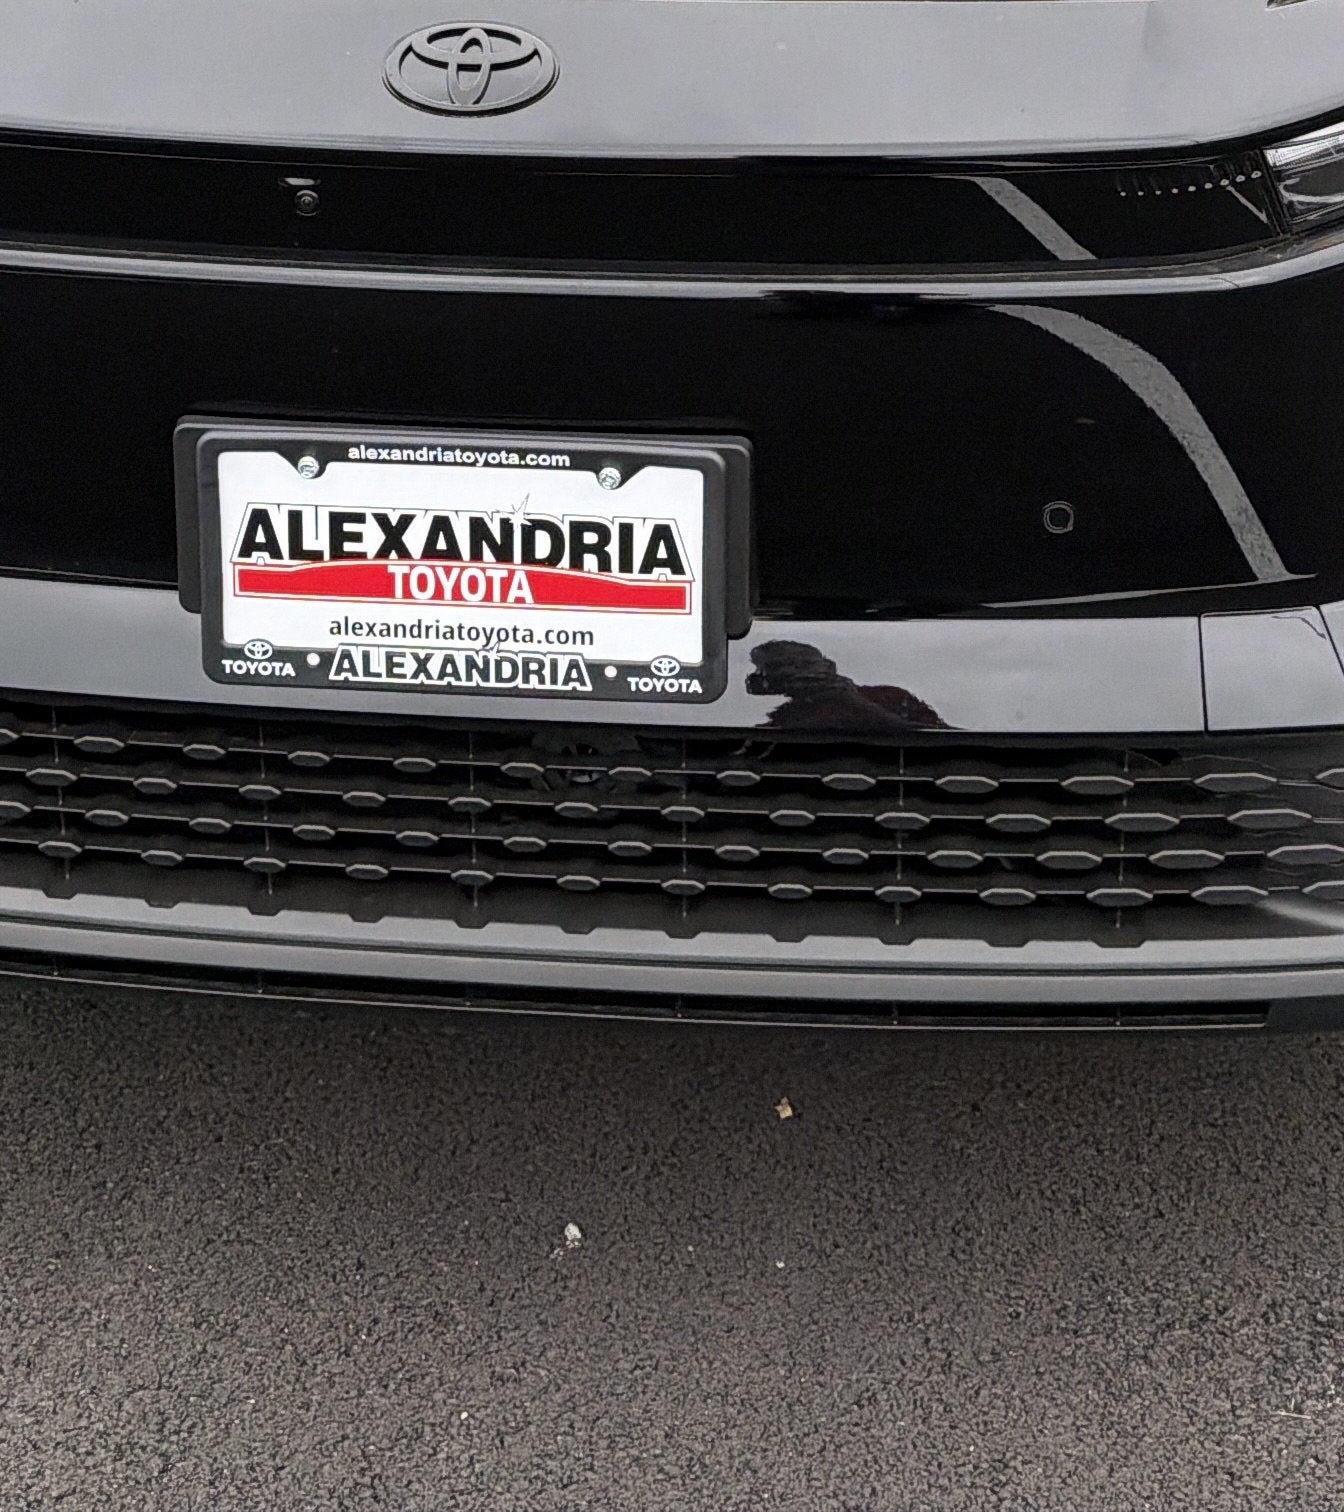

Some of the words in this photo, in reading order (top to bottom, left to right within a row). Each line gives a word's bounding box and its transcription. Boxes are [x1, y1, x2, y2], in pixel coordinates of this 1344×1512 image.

[347, 445, 571, 467] alexandriatoyota.com
[236, 506, 687, 577] ALEXANDRIA
[387, 564, 535, 604] TOYOTA
[329, 616, 595, 648] alexandriatoyota.com
[221, 659, 296, 677] TOYOTA
[330, 645, 592, 691] ALEXANDRIA
[627, 676, 703, 694] TOYOTA
